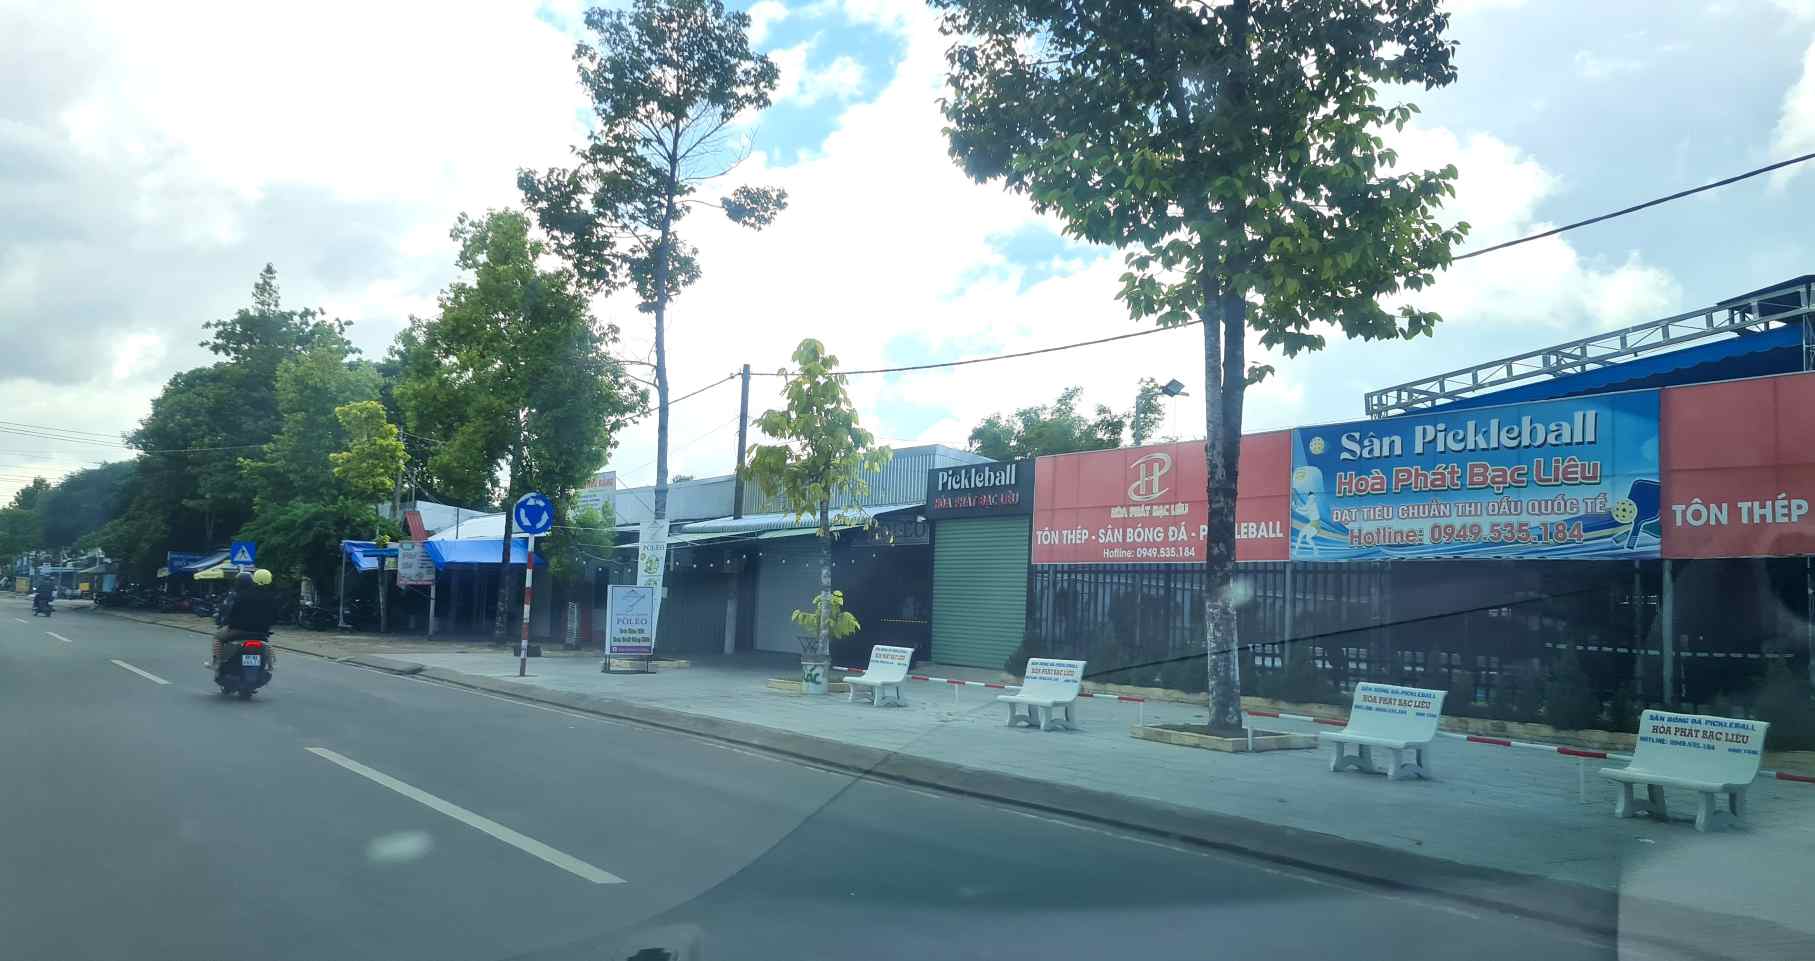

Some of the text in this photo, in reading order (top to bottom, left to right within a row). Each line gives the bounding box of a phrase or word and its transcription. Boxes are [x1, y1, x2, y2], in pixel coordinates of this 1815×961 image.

[1340, 410, 1598, 461] Sân Pickleball
[938, 464, 1016, 491] Pickleball
[1335, 456, 1601, 497] Hoà Phát Bạc Liêu
[1332, 508, 1358, 525] ĐẠT
[1398, 499, 1451, 520] CHUẨN
[1455, 502, 1482, 516] THI
[1487, 496, 1522, 516] ĐẤU
[1527, 494, 1580, 517] QUỐC
[1583, 492, 1609, 513] TẾ
[1671, 492, 1809, 527] TÔN THÉP
[1036, 526, 1060, 545] TÔN
[1062, 526, 1089, 545] THÉP
[1098, 524, 1123, 544] SÂN
[1126, 522, 1164, 543] BÓNG
[1168, 521, 1188, 542] ĐÁ
[1199, 521, 1284, 541] PLEBALL
[1349, 520, 1584, 548] Hotline: 0949.535.184
[1103, 548, 1135, 558] Hotline:
